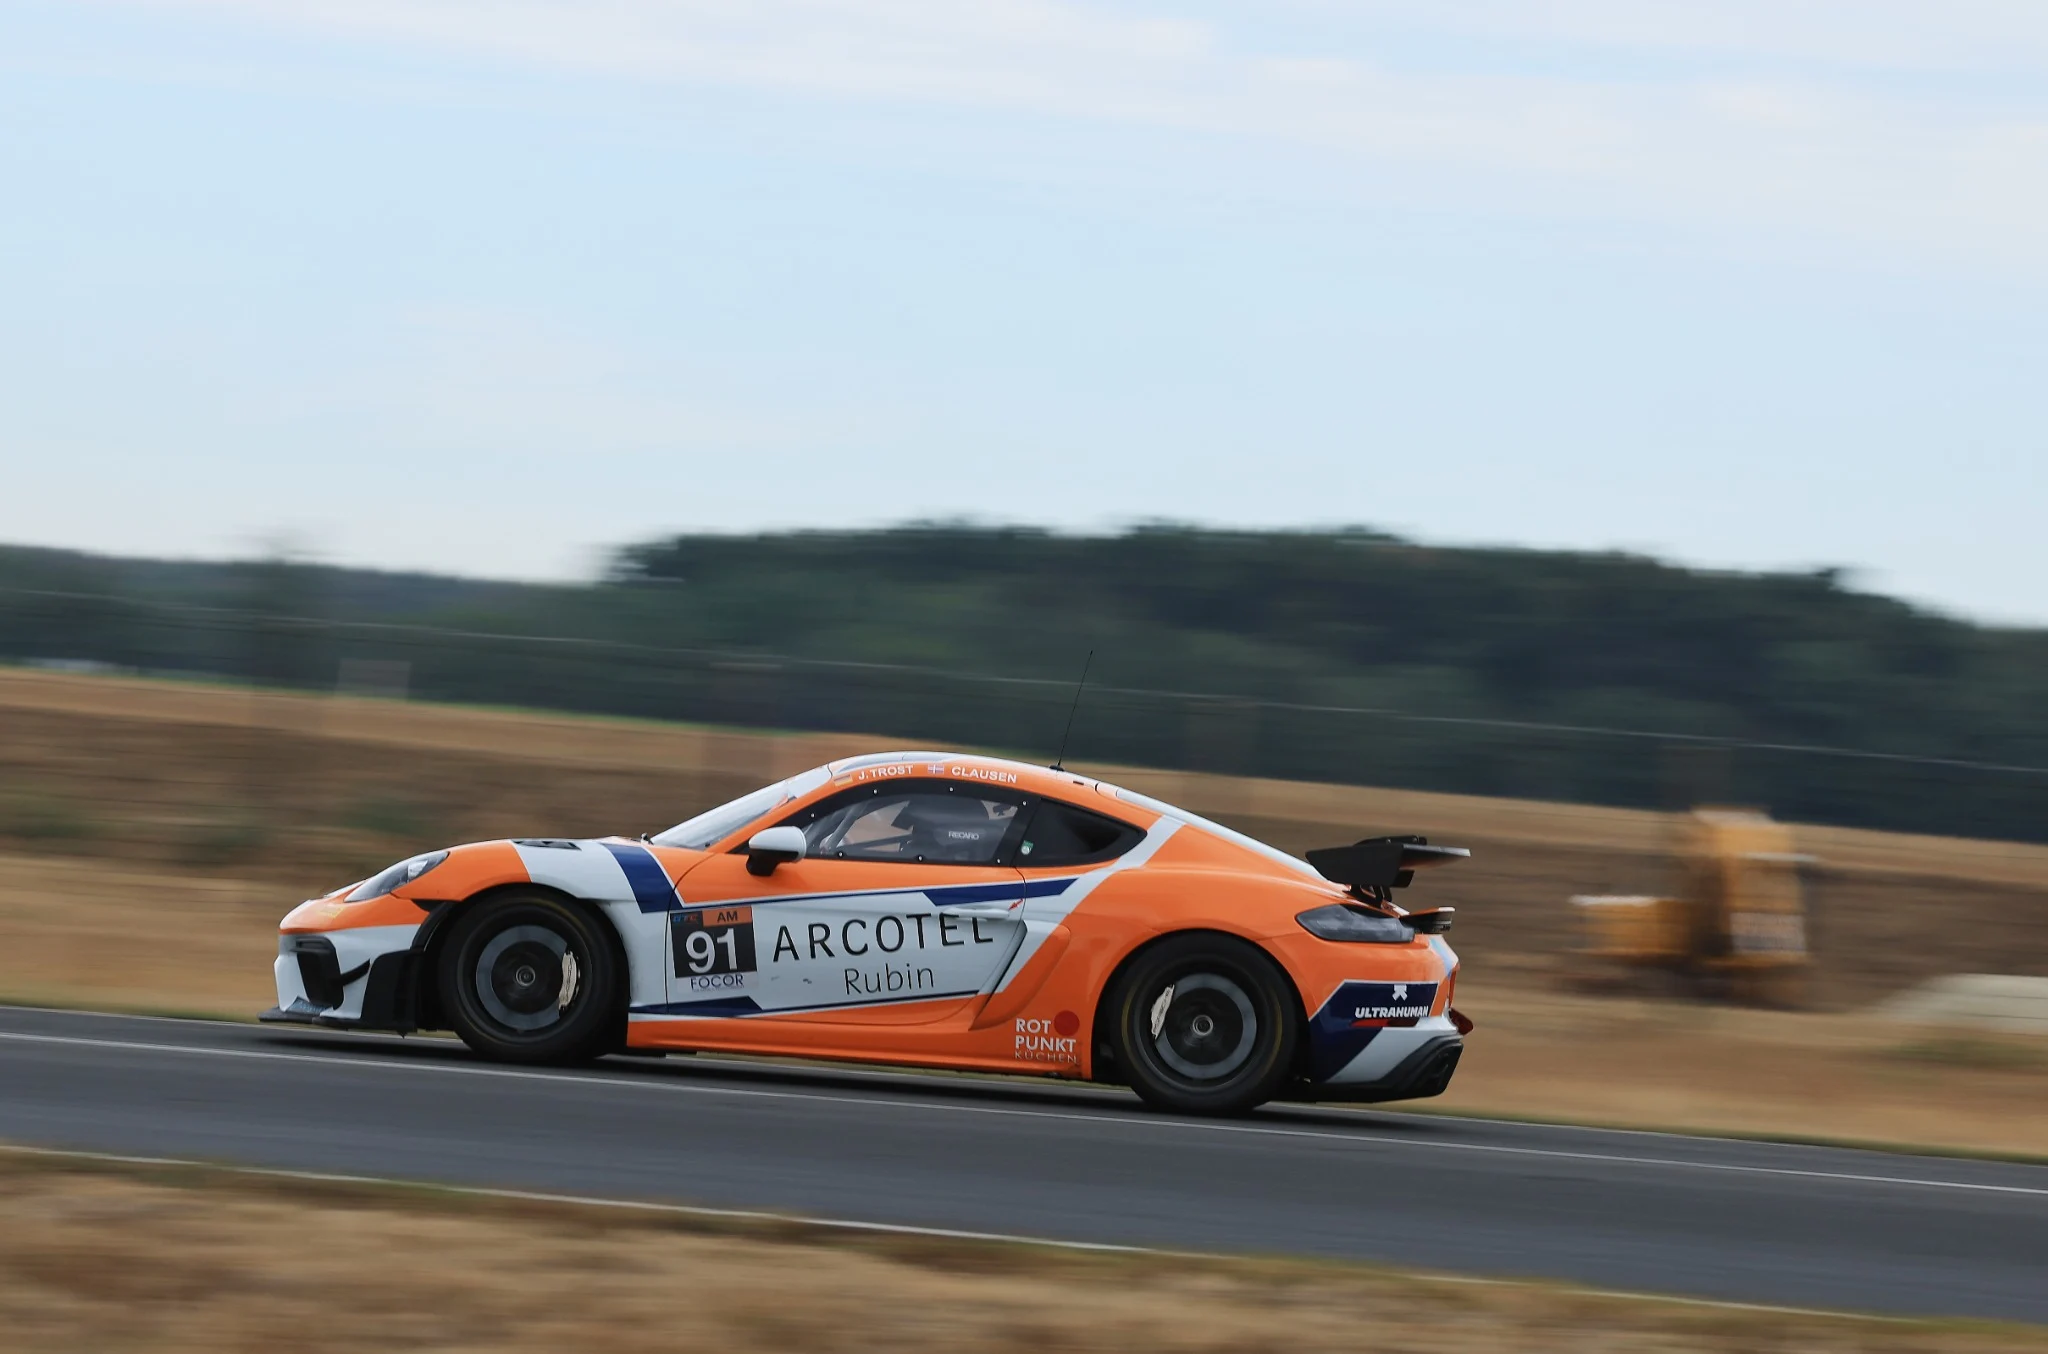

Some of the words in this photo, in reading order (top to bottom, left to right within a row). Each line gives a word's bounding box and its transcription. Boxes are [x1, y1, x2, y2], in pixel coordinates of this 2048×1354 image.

[951, 766, 1017, 784] CLAUSEN
[948, 831, 980, 841] RECARO
[717, 910, 739, 923] AM
[772, 912, 994, 963] ARCOTEL
[685, 928, 738, 974] 91
[690, 973, 745, 990] FOCOR
[844, 963, 935, 995] Rubin
[1354, 1005, 1430, 1019] ULTRAHUMAN
[1015, 1018, 1052, 1034] ROT
[1015, 1034, 1077, 1053] PUNKT
[1014, 1049, 1077, 1064] KÜCHEN
